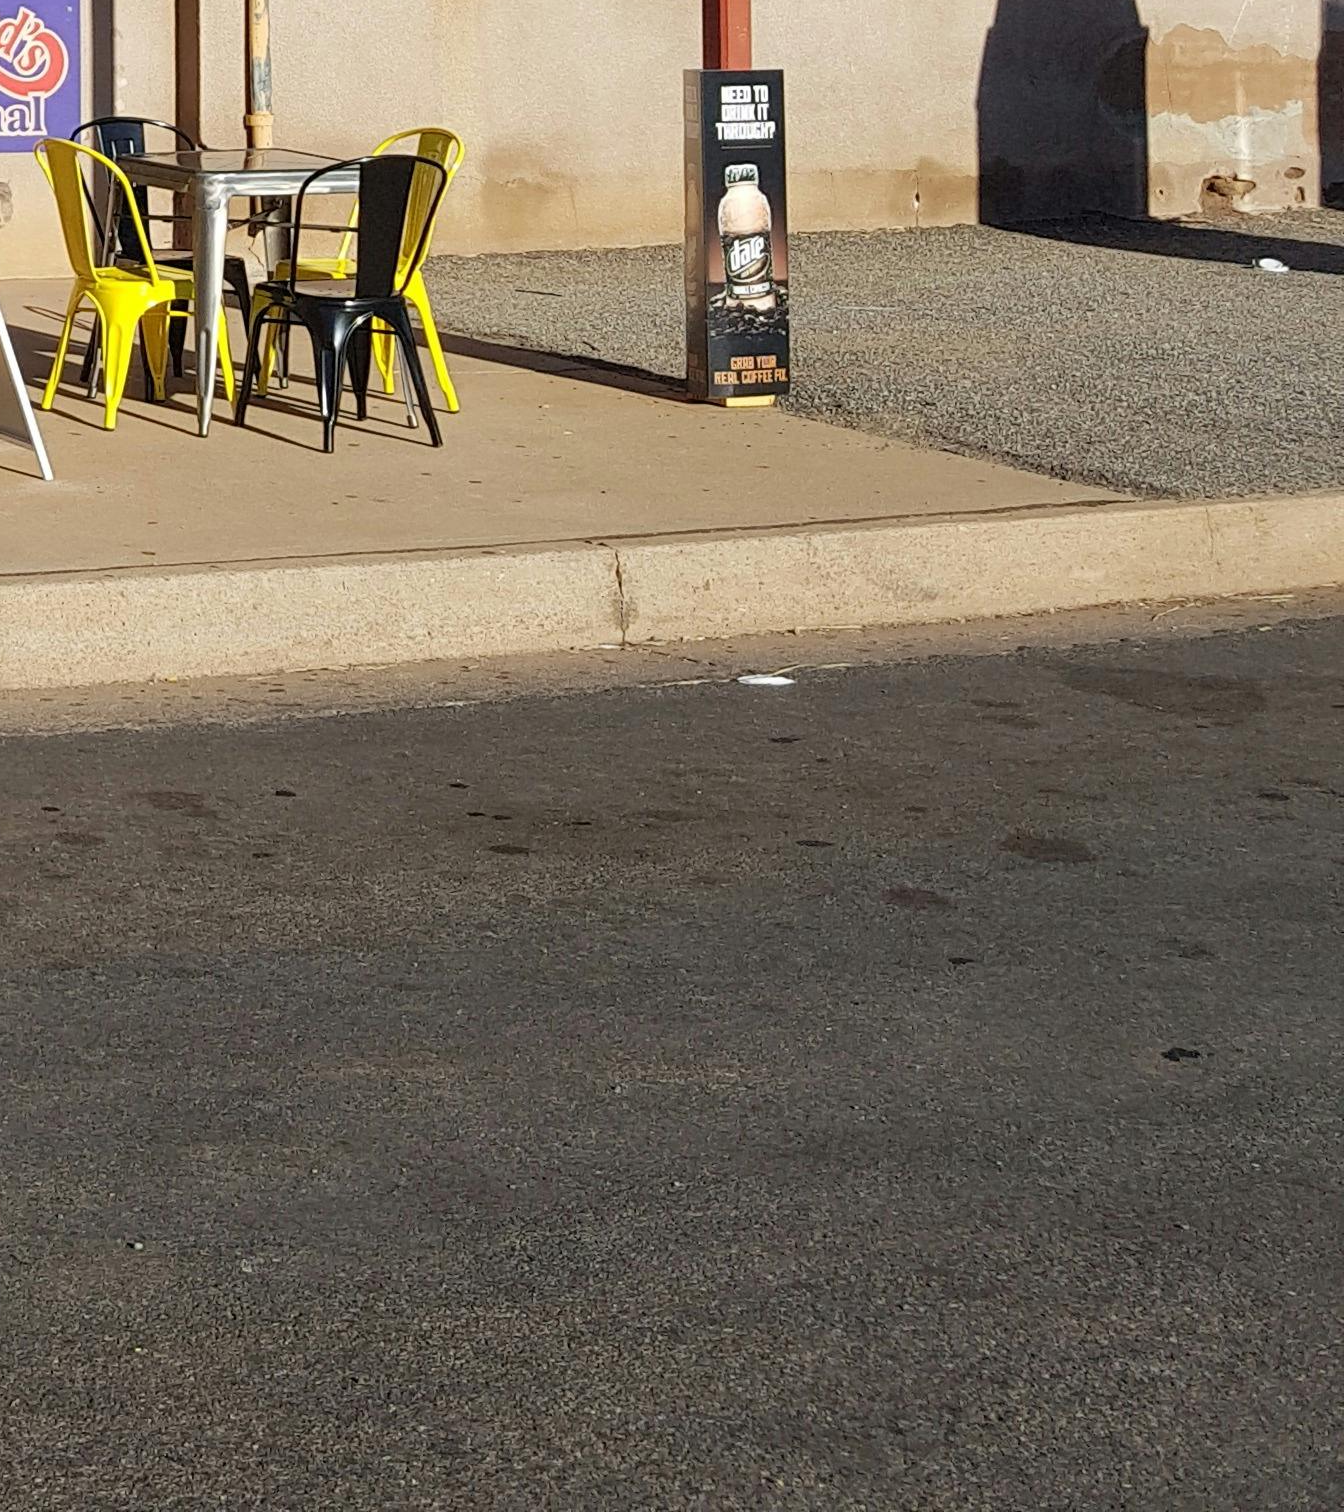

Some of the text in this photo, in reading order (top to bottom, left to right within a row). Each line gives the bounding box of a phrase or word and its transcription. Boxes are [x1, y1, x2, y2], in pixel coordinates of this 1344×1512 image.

[753, 85, 768, 102] TO
[757, 104, 769, 120] IT
[730, 236, 765, 271] dare
